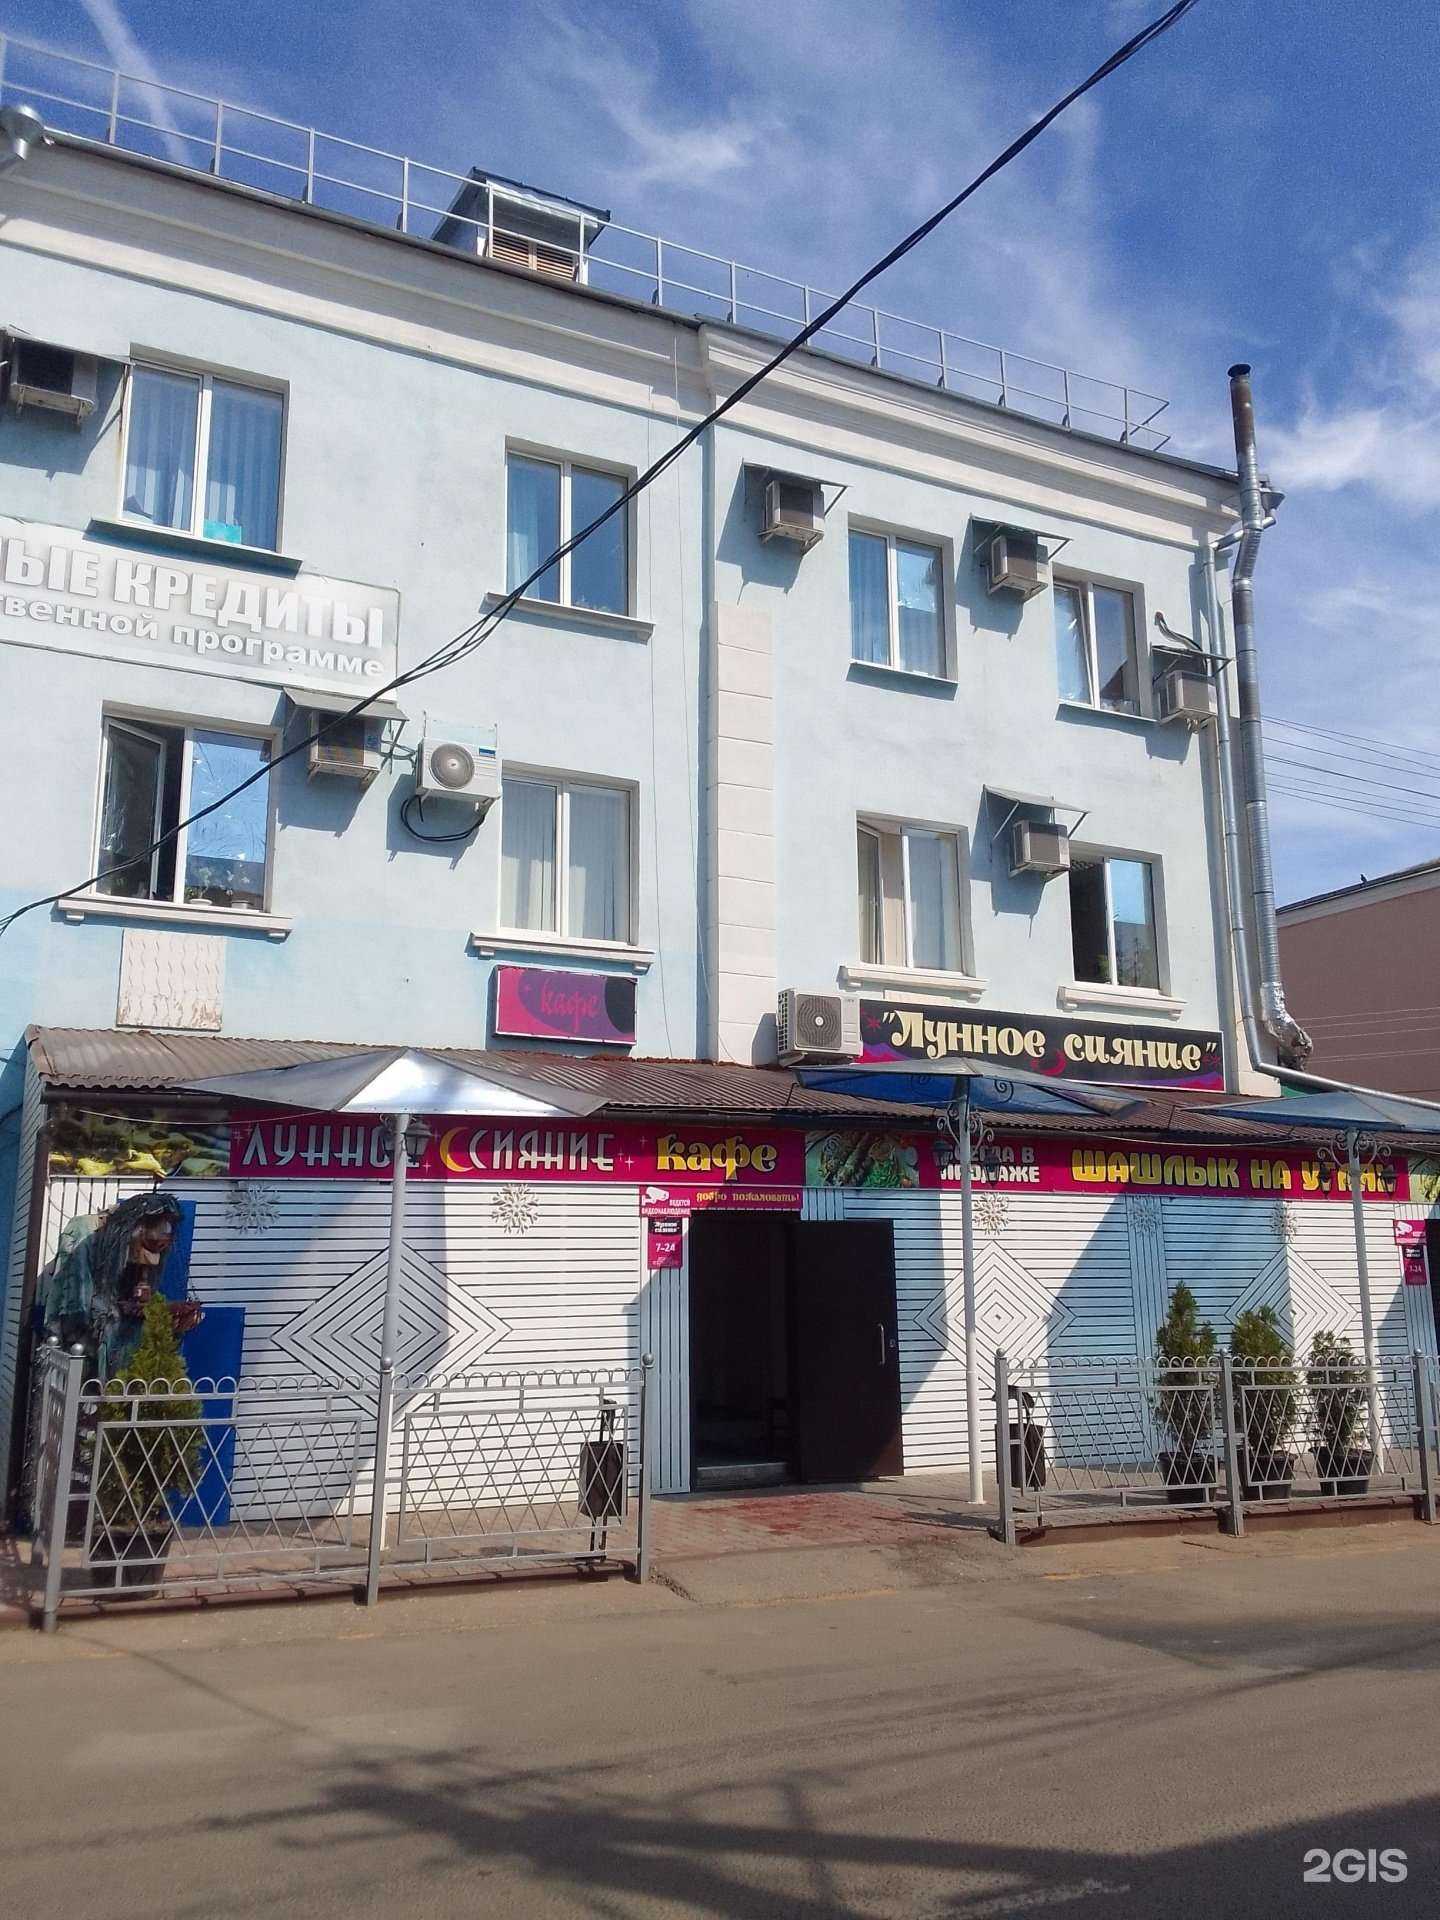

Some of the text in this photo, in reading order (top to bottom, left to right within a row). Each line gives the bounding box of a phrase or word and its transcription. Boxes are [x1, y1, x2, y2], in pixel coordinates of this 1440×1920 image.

[0, 534, 385, 650] ЫЕ КРЕДИТЫ
[0, 594, 386, 678] венной программе
[882, 1009, 1218, 1072] "Лунное сияние"
[242, 1124, 778, 1181] ЛУННО СИЯНИЕ кафе
[1022, 1146, 1035, 1164] В
[1071, 1147, 1240, 1189] ШАШЛЫК
[1249, 1158, 1292, 1190] НА
